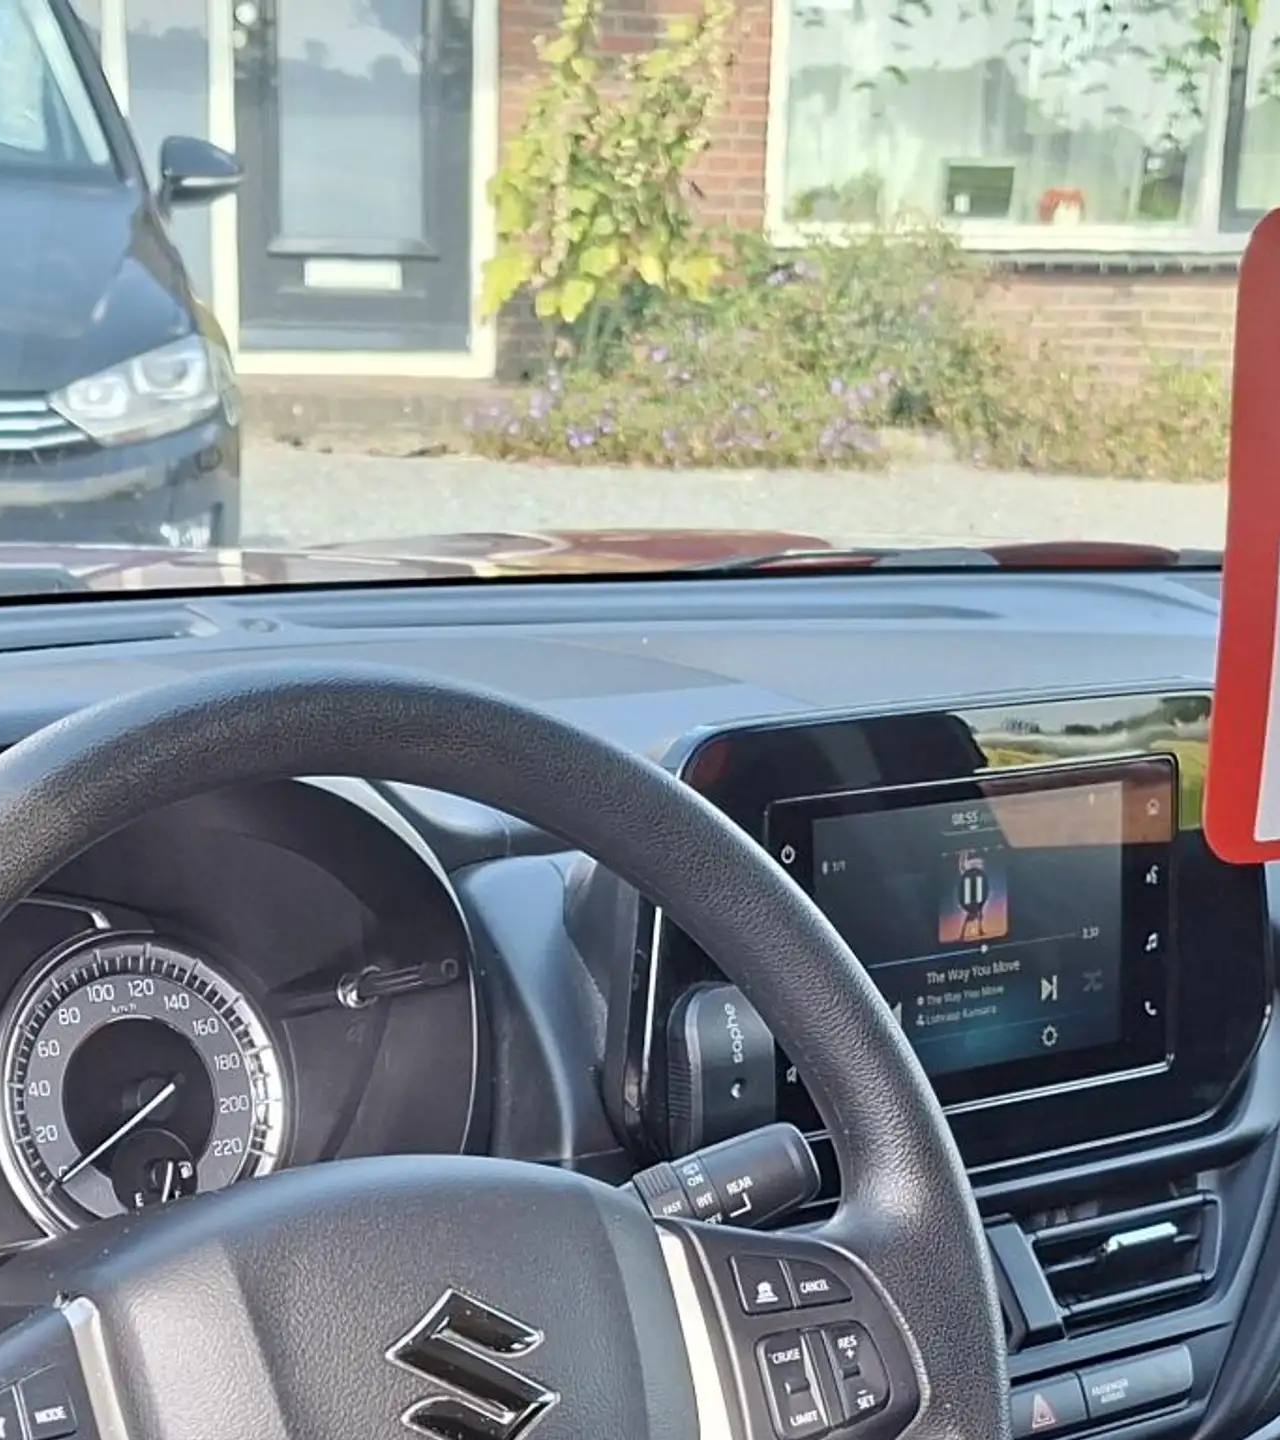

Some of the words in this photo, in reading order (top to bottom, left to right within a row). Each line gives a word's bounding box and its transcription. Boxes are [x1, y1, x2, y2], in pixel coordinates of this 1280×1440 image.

[926, 971, 945, 985] The
[948, 968, 970, 983] Way
[972, 965, 991, 977] You
[993, 960, 1020, 974] Move
[87, 985, 115, 1003] 100
[128, 979, 154, 997] 120
[164, 993, 190, 1010] 140
[59, 1007, 81, 1025] 80
[193, 1018, 219, 1036] 160
[36, 1039, 61, 1058] 60
[214, 1053, 240, 1071] 180
[28, 1080, 51, 1098] 40
[220, 1095, 249, 1113] 200
[36, 1124, 58, 1144] 20
[213, 1138, 243, 1156] 220
[726, 1176, 753, 1196] REAR
[134, 1192, 144, 1207] E
[800, 1279, 830, 1294] CANCEL
[837, 1335, 858, 1349] RES
[772, 1348, 801, 1364] CRUISE
[857, 1395, 876, 1411] SET
[34, 1406, 67, 1425] MODE
[790, 1410, 819, 1427] LIMIT
